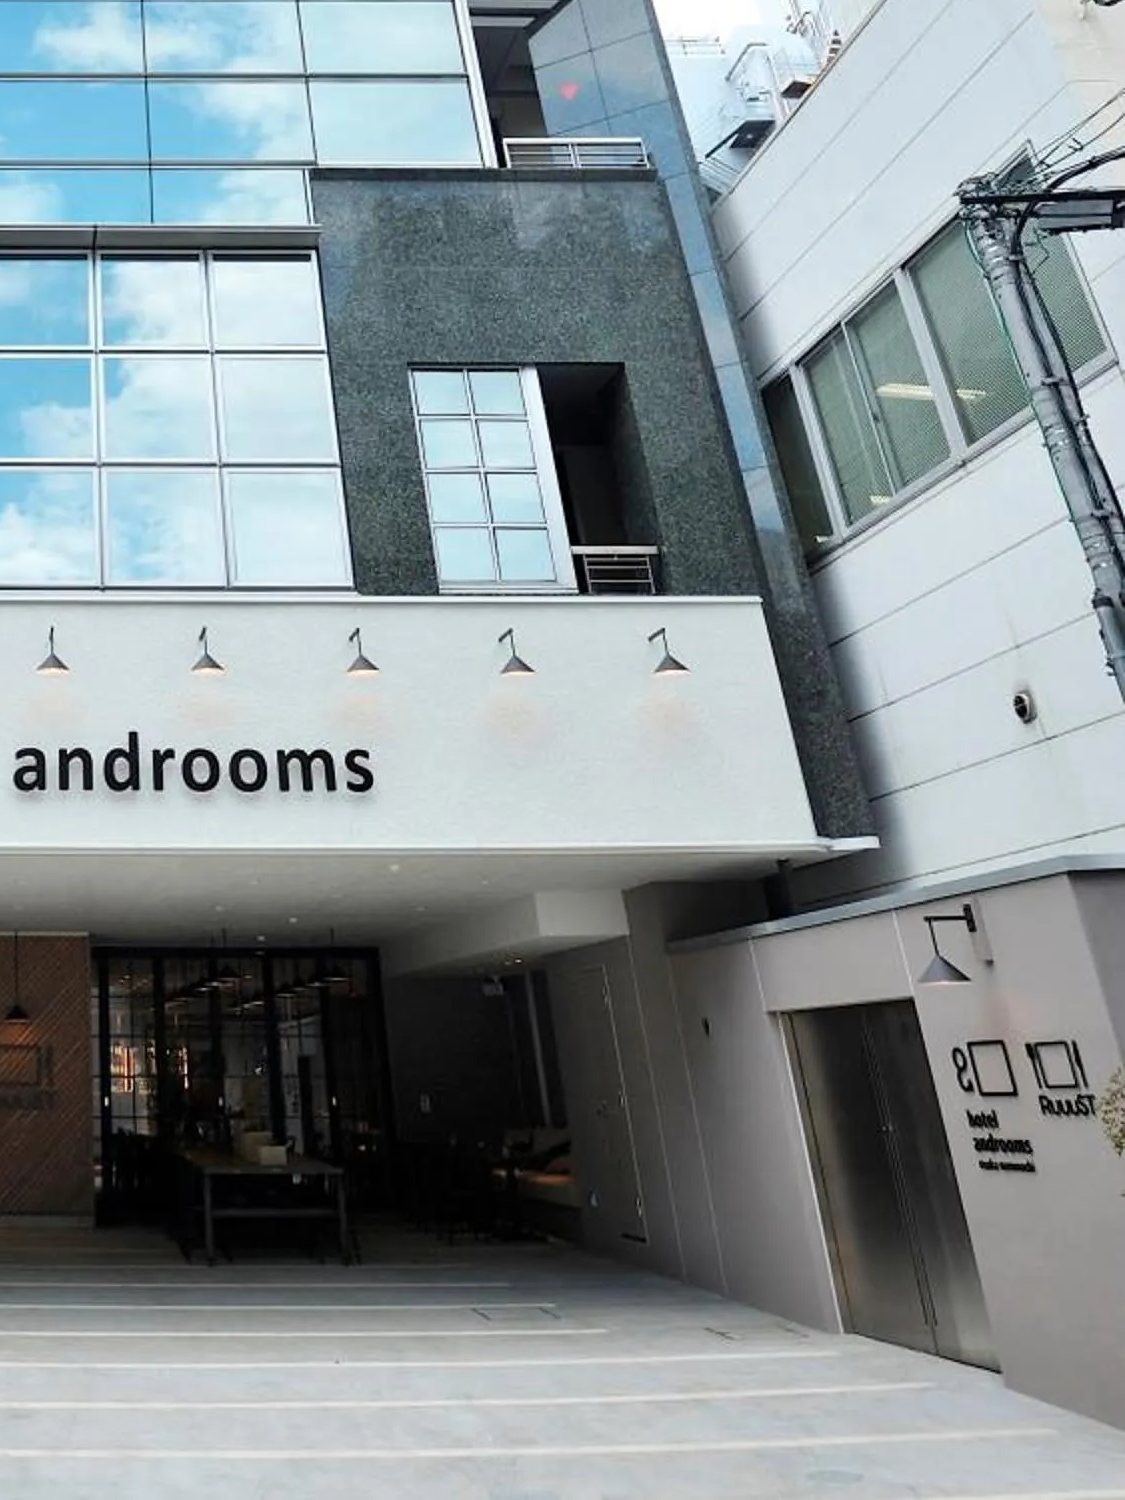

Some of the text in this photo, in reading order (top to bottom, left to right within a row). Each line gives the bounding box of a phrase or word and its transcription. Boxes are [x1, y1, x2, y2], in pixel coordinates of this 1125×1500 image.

[14, 732, 372, 792] androoms
[966, 1109, 999, 1129] hotel
[973, 1132, 1034, 1155] androoms
